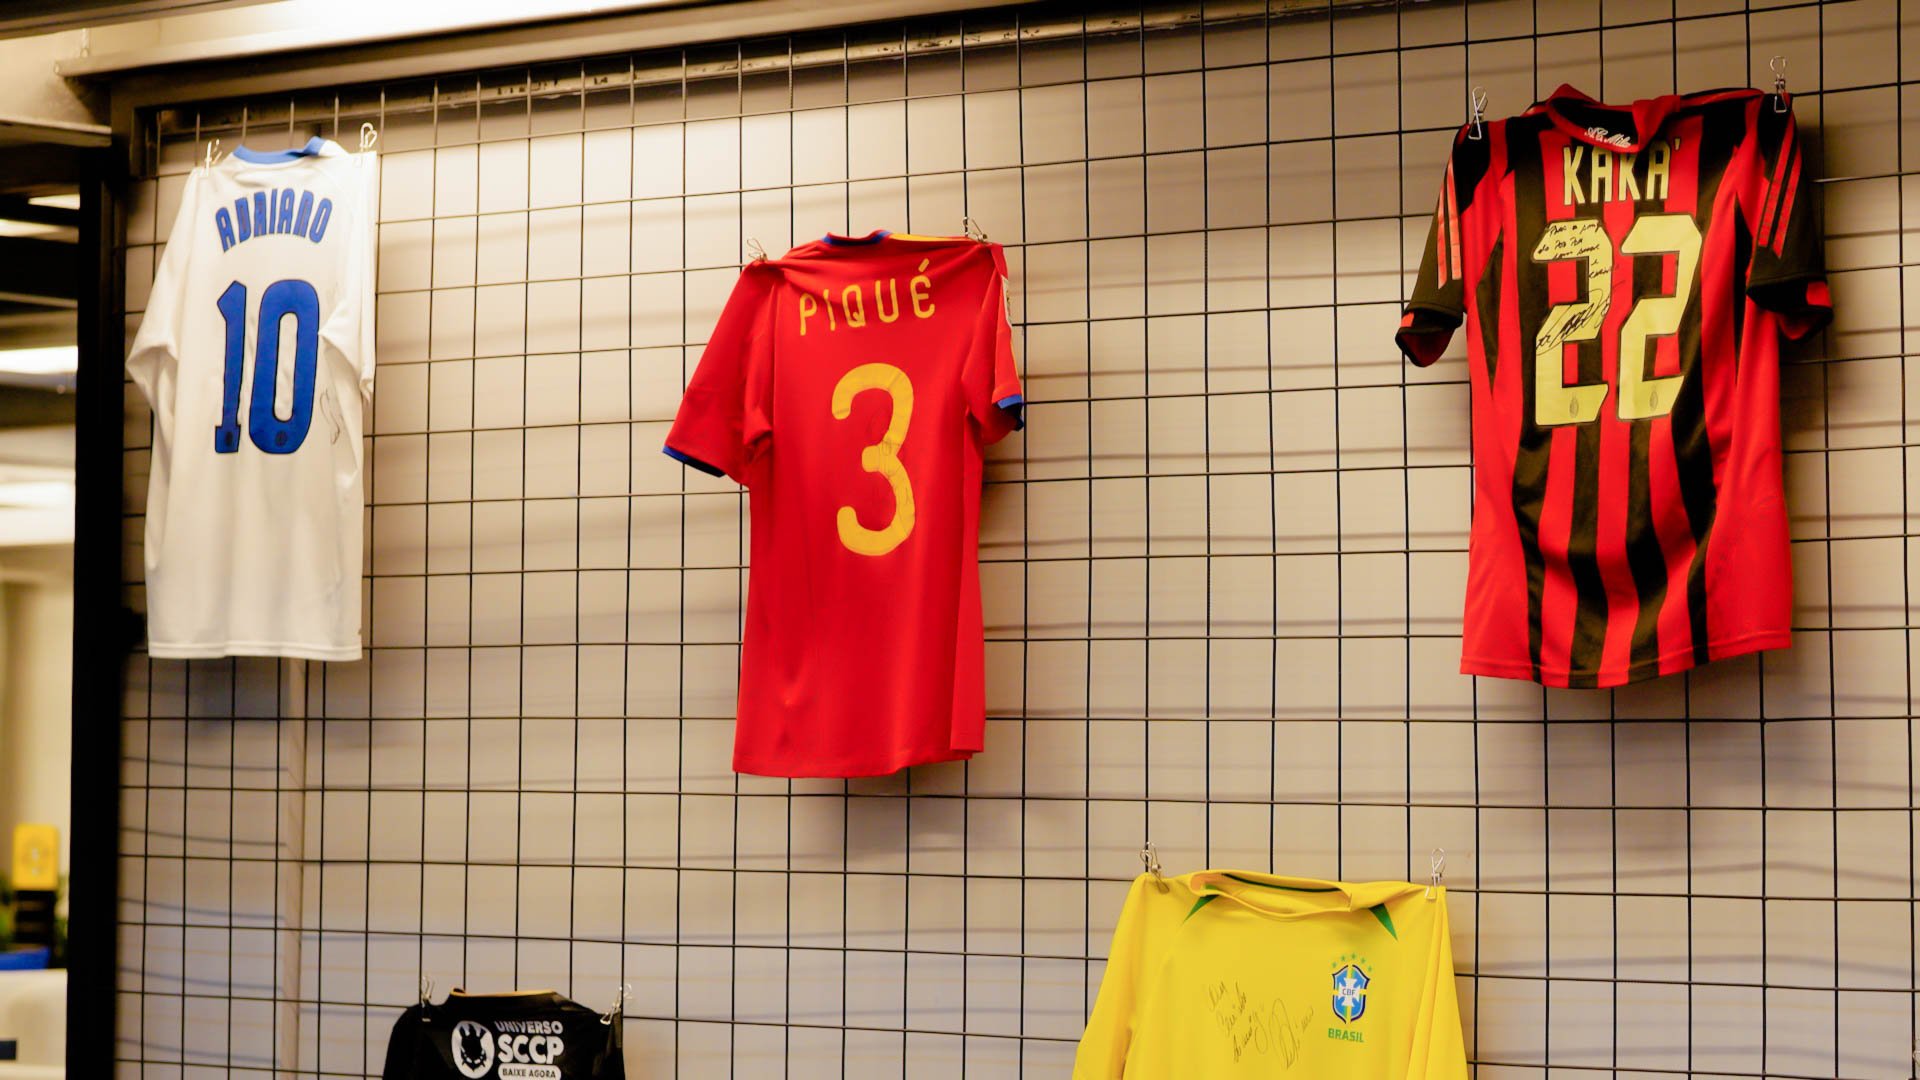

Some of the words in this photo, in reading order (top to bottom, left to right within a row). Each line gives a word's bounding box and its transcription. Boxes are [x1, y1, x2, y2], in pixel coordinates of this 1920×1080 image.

[215, 187, 333, 253] ADRIANO
[799, 258, 936, 337] PIQUÉ
[1532, 214, 1702, 426] 22
[214, 279, 320, 455] 10
[831, 362, 916, 556] 3
[494, 1020, 563, 1034] UNIVERSO
[497, 1033, 564, 1064] SCCP
[1327, 1027, 1364, 1043] BRASIL
[502, 1068, 527, 1077] BAIXE
[528, 1069, 556, 1078] AGORA
